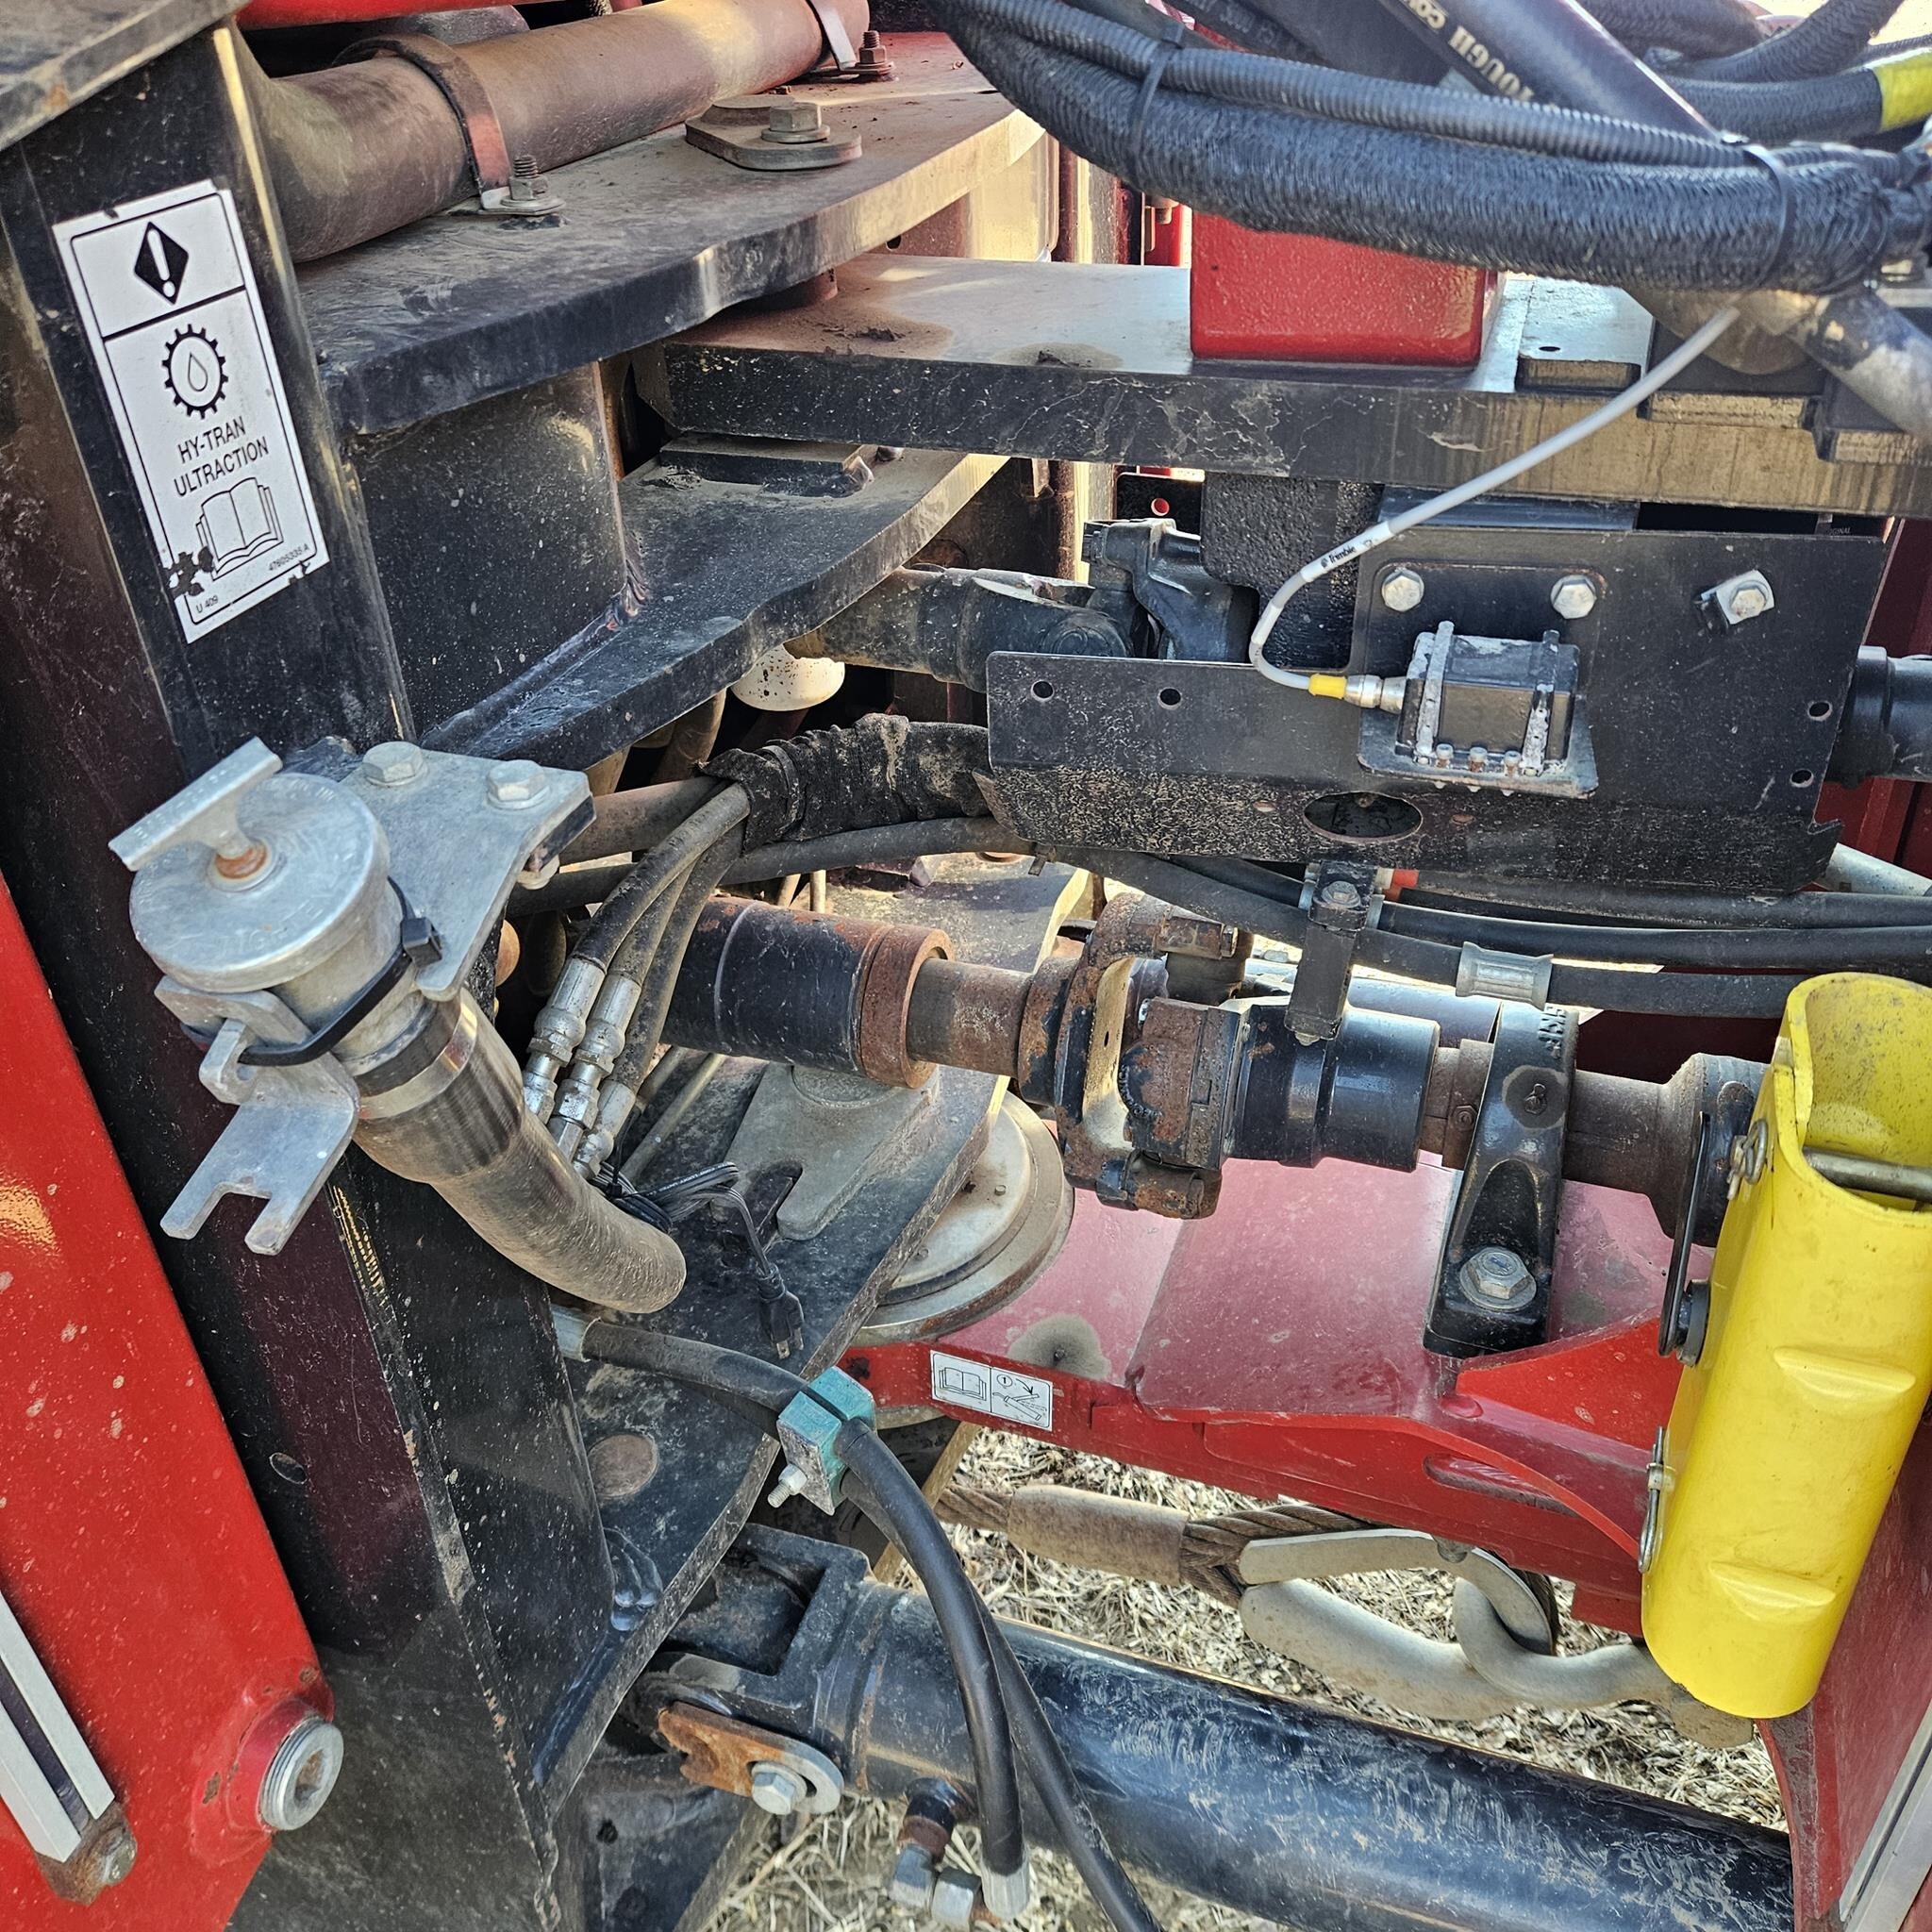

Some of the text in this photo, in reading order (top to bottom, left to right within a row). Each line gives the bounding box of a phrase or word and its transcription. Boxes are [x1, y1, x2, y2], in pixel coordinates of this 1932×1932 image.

[177, 415, 246, 464] HY-TRAN
[174, 436, 269, 496] ULTRACTION
[1328, 546, 1356, 563] Trimble
[195, 594, 218, 613] U 409
